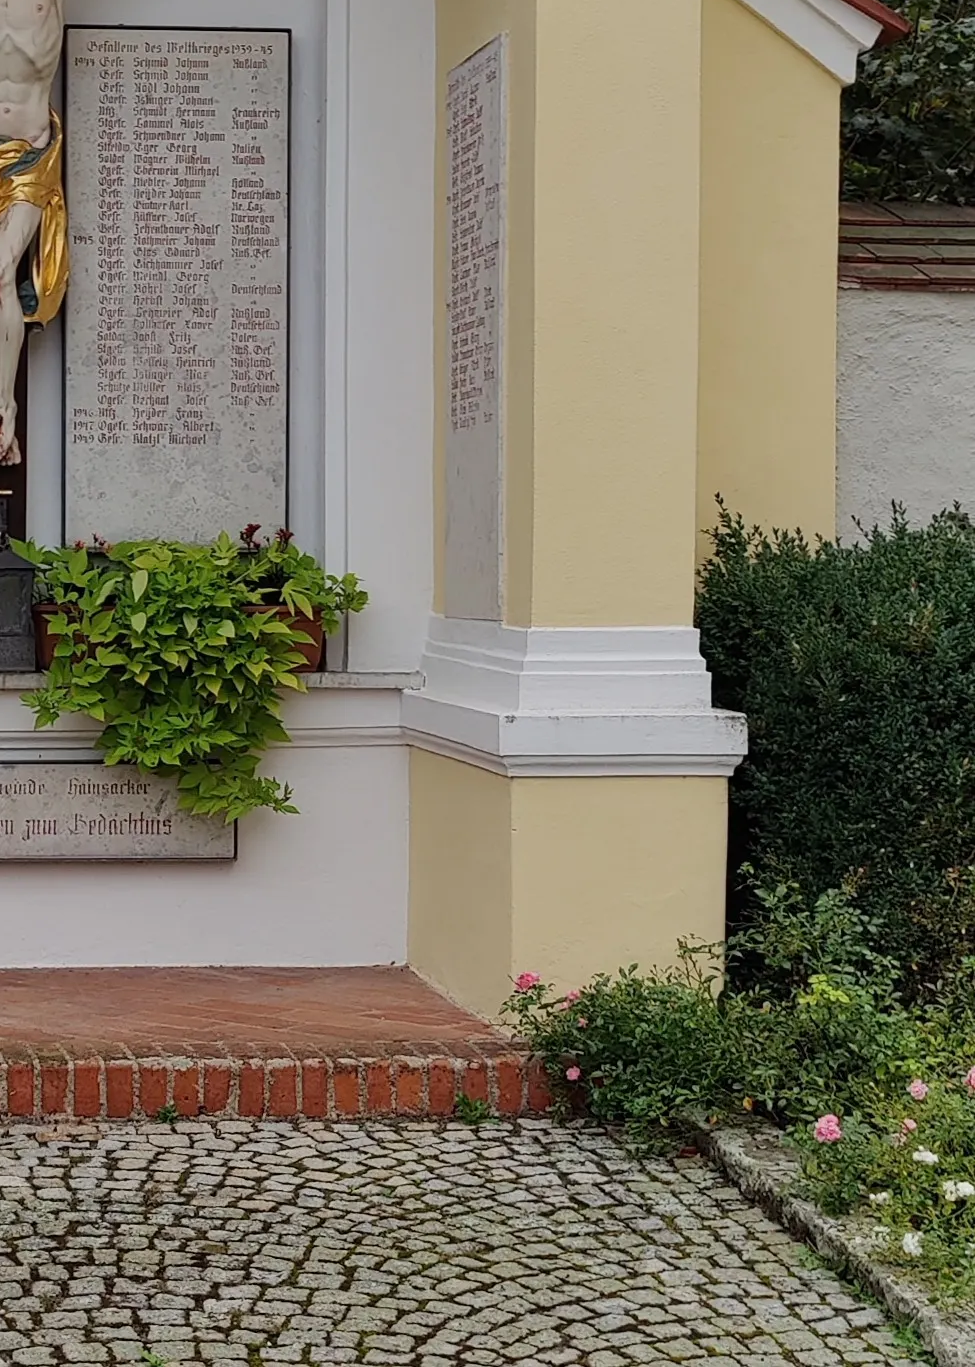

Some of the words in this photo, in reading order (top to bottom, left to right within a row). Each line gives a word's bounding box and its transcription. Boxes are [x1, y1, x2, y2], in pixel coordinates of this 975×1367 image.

[144, 41, 161, 53] des
[133, 57, 168, 68] Schmid
[133, 69, 168, 82] Schmid
[163, 84, 200, 95] Johann
[22, 817, 57, 841] zum
